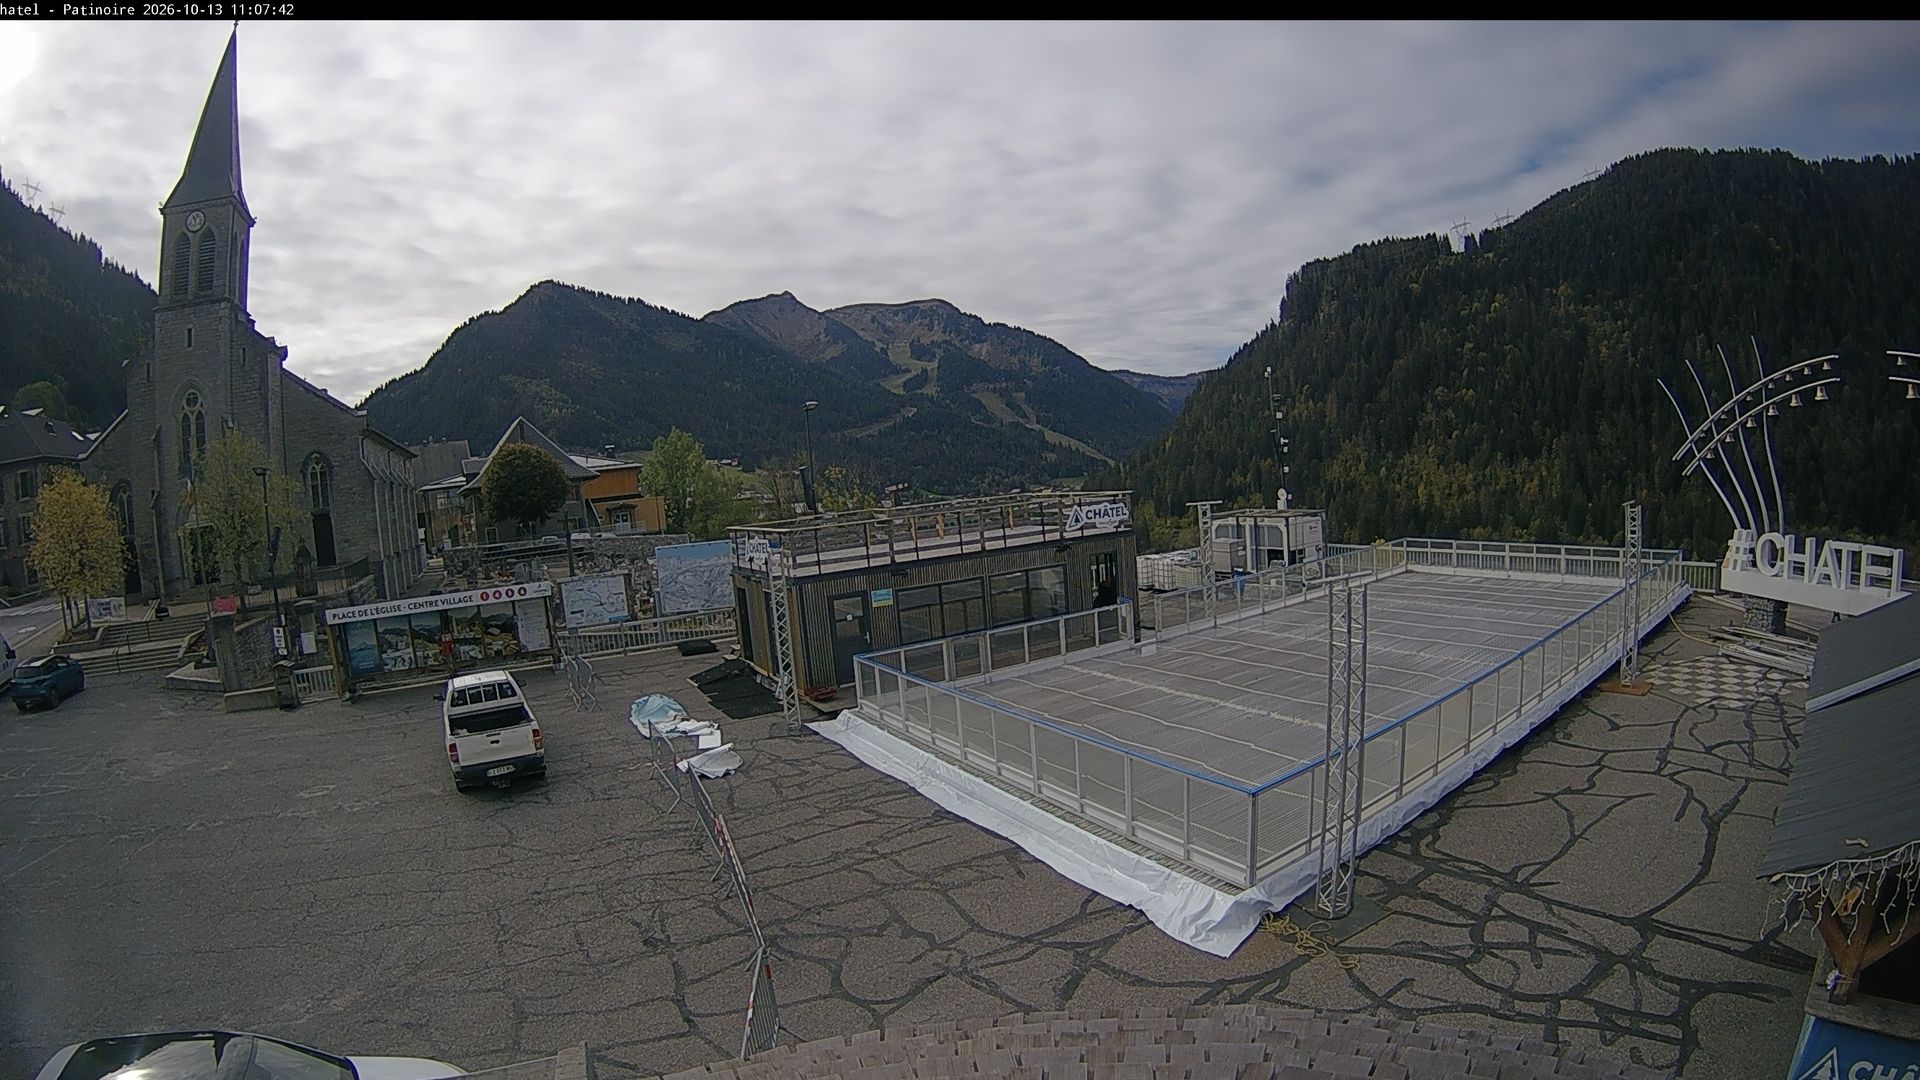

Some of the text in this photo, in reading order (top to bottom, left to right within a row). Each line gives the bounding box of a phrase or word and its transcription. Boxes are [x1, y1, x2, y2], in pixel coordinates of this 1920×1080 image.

[1085, 505, 1127, 520] CHÂTEL
[332, 609, 356, 620] PLACE
[358, 607, 370, 618] DE
[370, 604, 402, 616] L'ÉGLISE
[408, 599, 440, 611] CENTRE
[440, 595, 474, 607] VILLAGE
